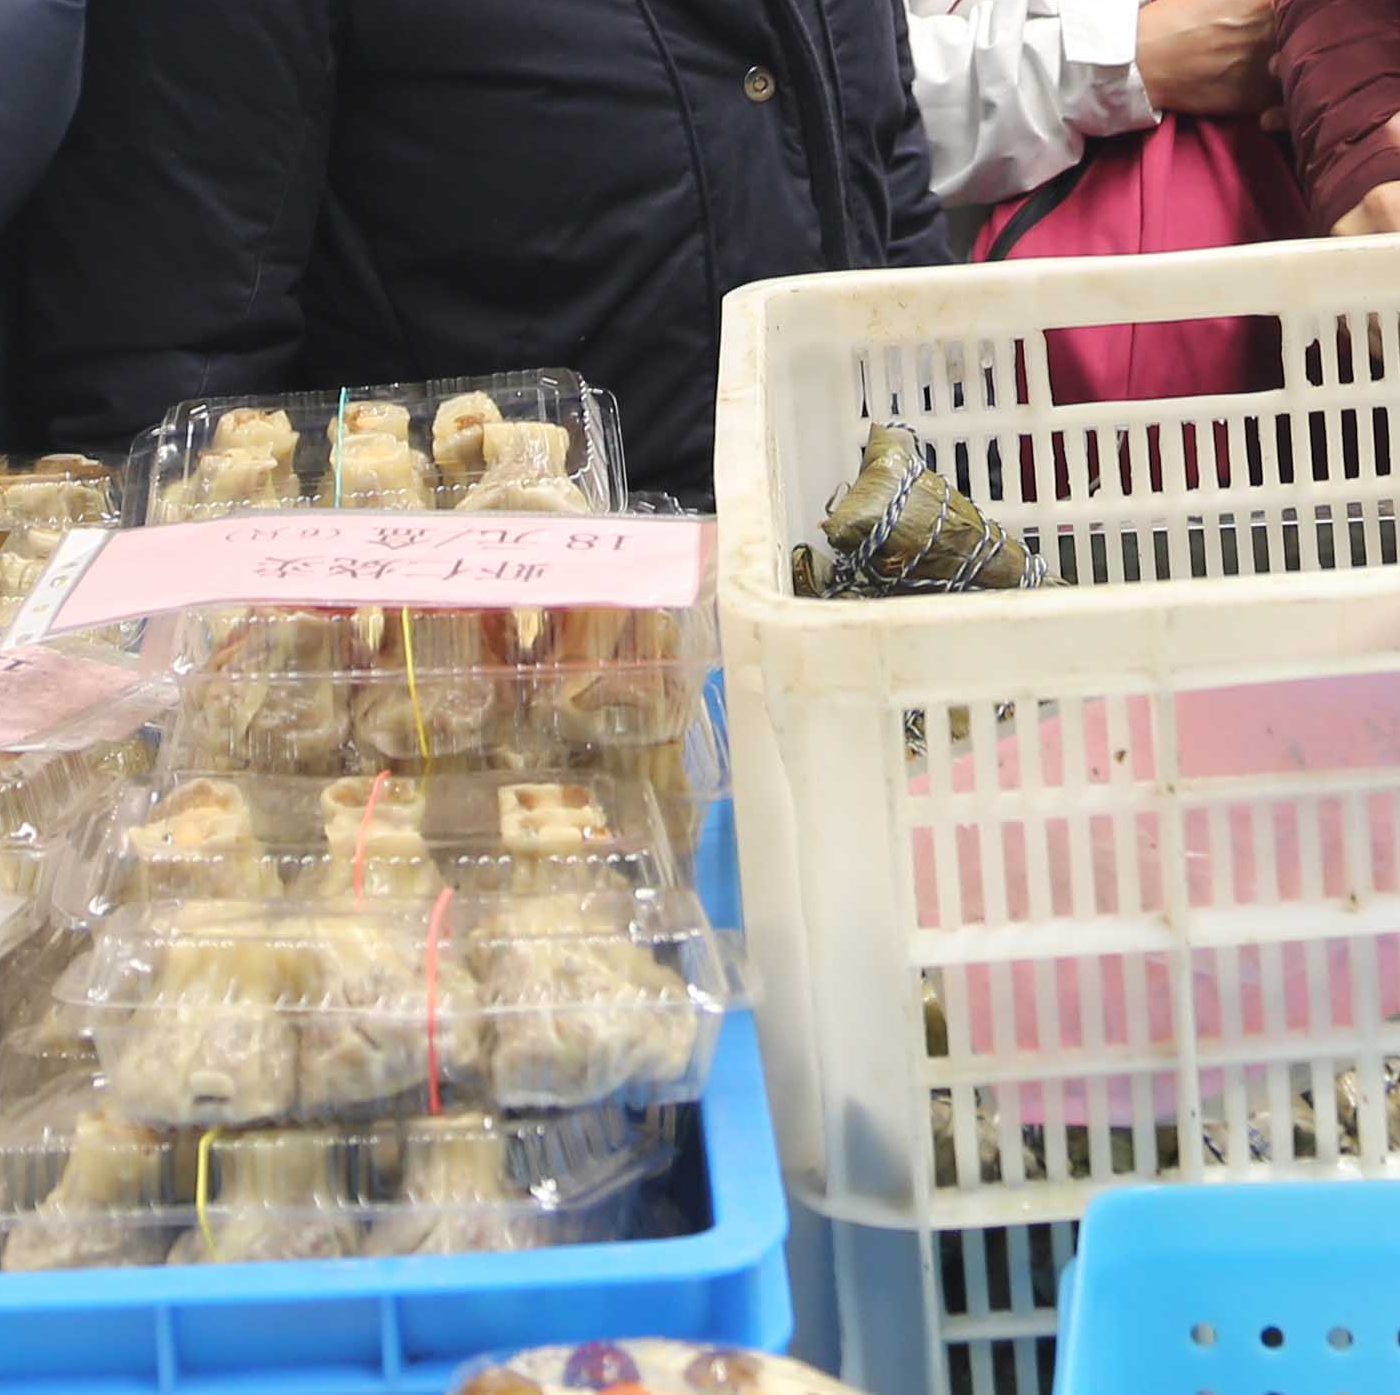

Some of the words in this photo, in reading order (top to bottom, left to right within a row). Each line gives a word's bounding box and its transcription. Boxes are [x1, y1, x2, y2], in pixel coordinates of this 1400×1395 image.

[567, 532, 629, 551] 18
[253, 553, 551, 582] 虾仁烧卖
